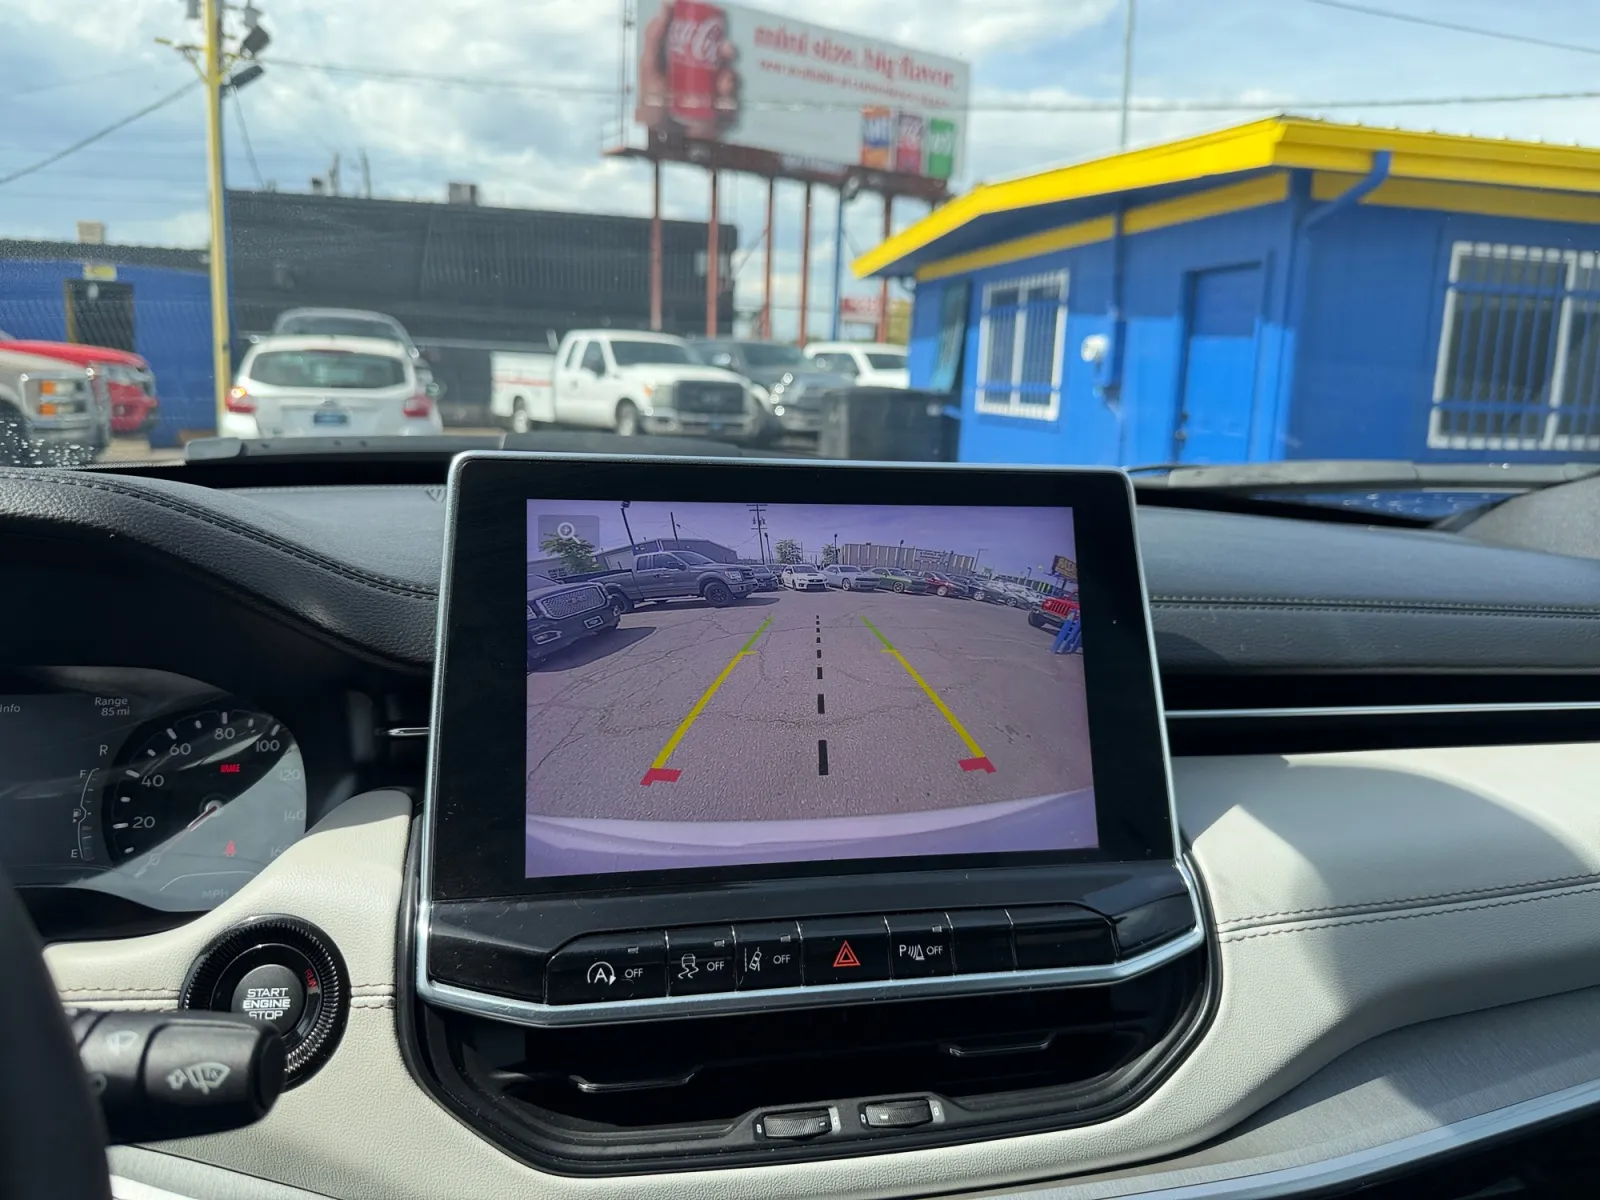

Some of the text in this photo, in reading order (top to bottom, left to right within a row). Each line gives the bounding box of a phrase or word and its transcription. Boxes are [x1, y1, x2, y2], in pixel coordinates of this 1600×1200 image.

[94, 697, 128, 707] Range
[101, 706, 130, 716] 85 mi
[214, 728, 235, 740] 80
[99, 744, 109, 756] R
[169, 743, 192, 756] 60
[255, 739, 280, 753] 100
[80, 769, 88, 778] F
[279, 769, 301, 781] 120
[141, 774, 165, 787] 40
[132, 816, 156, 829] 20
[71, 848, 78, 858] E
[202, 889, 229, 898] MPH
[926, 946, 943, 955] OFF
[773, 955, 791, 964] OFF
[706, 961, 725, 971] OFF
[304, 968, 318, 988] RUN
[624, 968, 644, 978] OFF
[247, 987, 289, 998] START
[242, 998, 291, 1009] ENGINE
[248, 1010, 284, 1020] STOP
